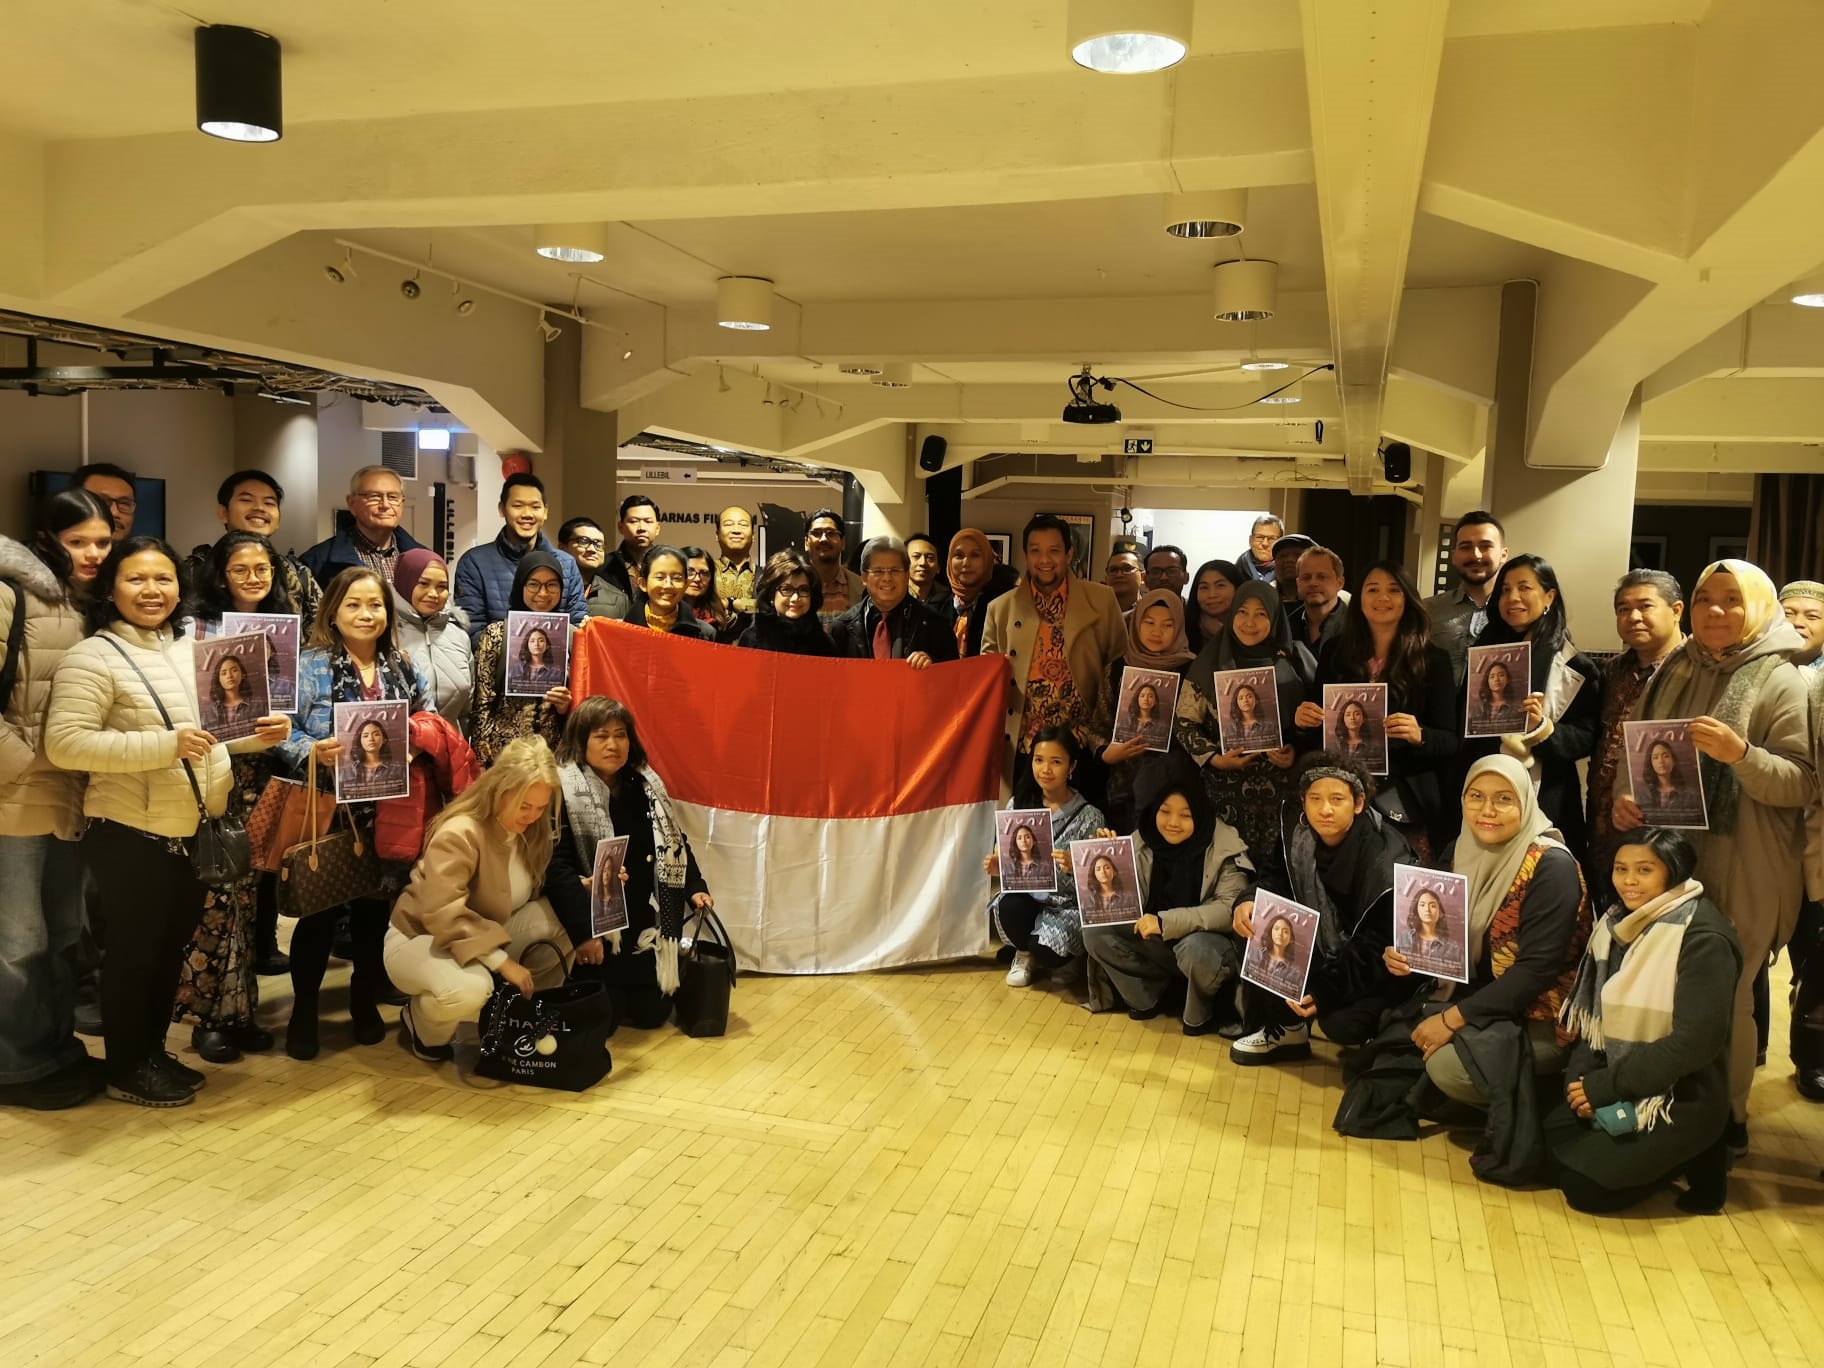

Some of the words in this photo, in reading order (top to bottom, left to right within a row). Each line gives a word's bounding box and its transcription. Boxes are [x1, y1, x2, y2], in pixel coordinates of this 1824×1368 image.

[645, 471, 670, 479] LILLEBIL
[446, 499, 454, 564] LILLEBIL
[509, 1018, 571, 1032] HAEL
[520, 1060, 557, 1069] CAMBON
[511, 1067, 535, 1076] PARIS
